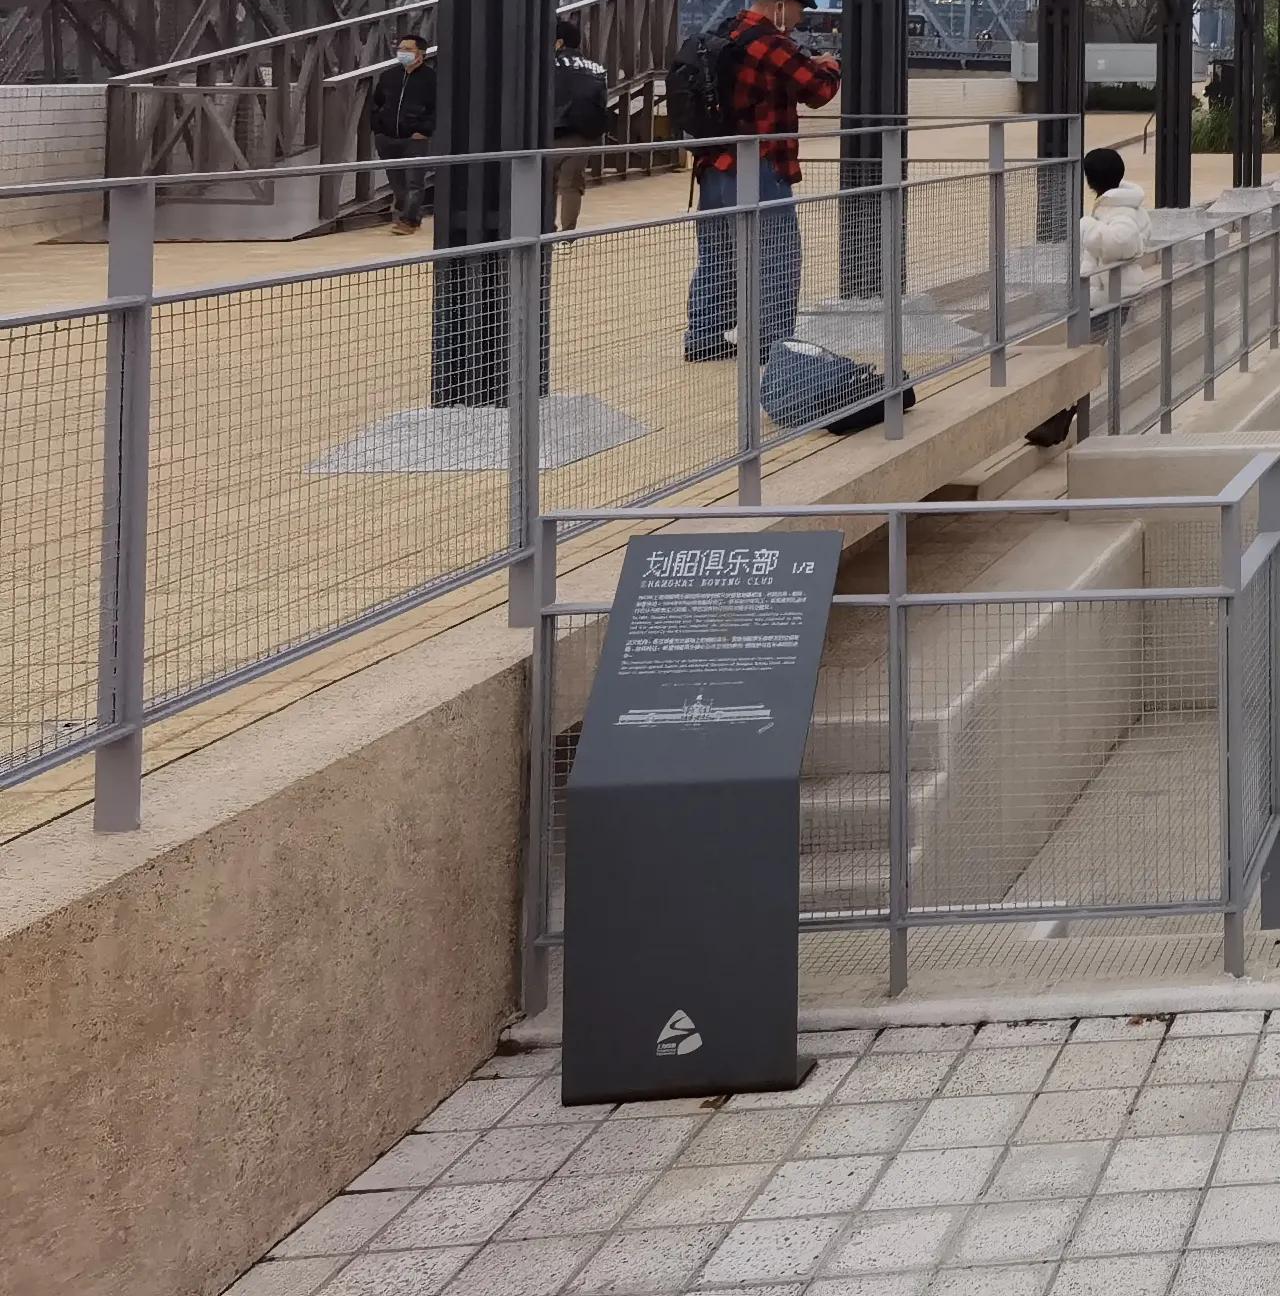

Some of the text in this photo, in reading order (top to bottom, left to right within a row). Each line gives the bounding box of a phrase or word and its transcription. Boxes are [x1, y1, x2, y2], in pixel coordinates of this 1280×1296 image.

[643, 548, 779, 577] 划船俱乐部
[792, 561, 815, 574] 1/2
